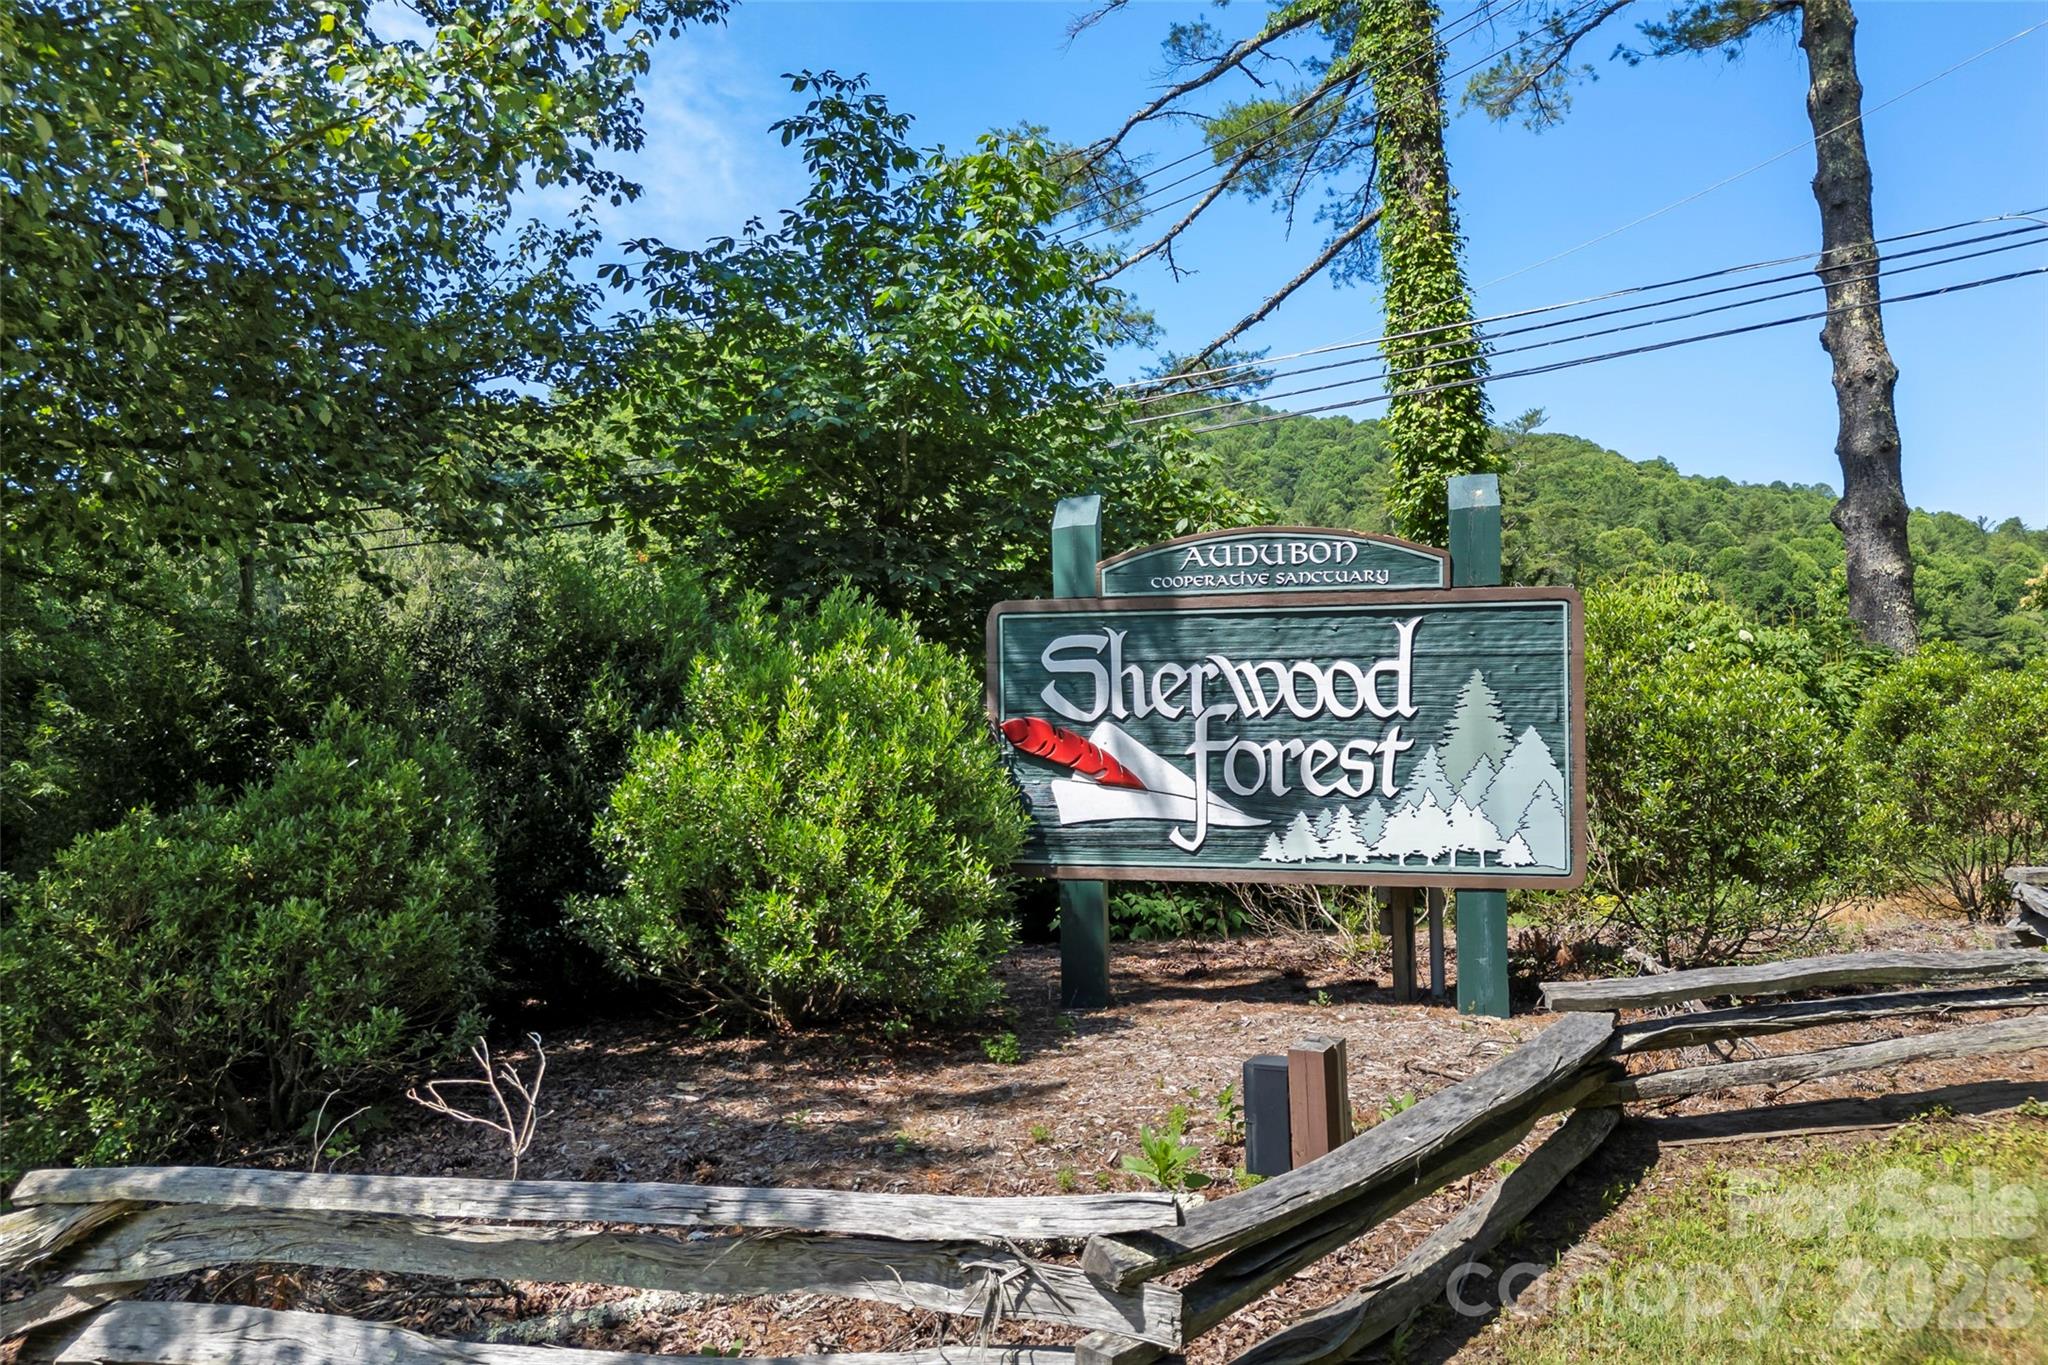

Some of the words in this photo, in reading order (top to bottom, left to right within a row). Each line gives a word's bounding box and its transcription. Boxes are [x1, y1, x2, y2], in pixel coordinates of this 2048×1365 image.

[1179, 541, 1358, 571] AUDUBON
[1276, 569, 1391, 586] SANCTUARY
[1040, 616, 1423, 722] Sherwood
